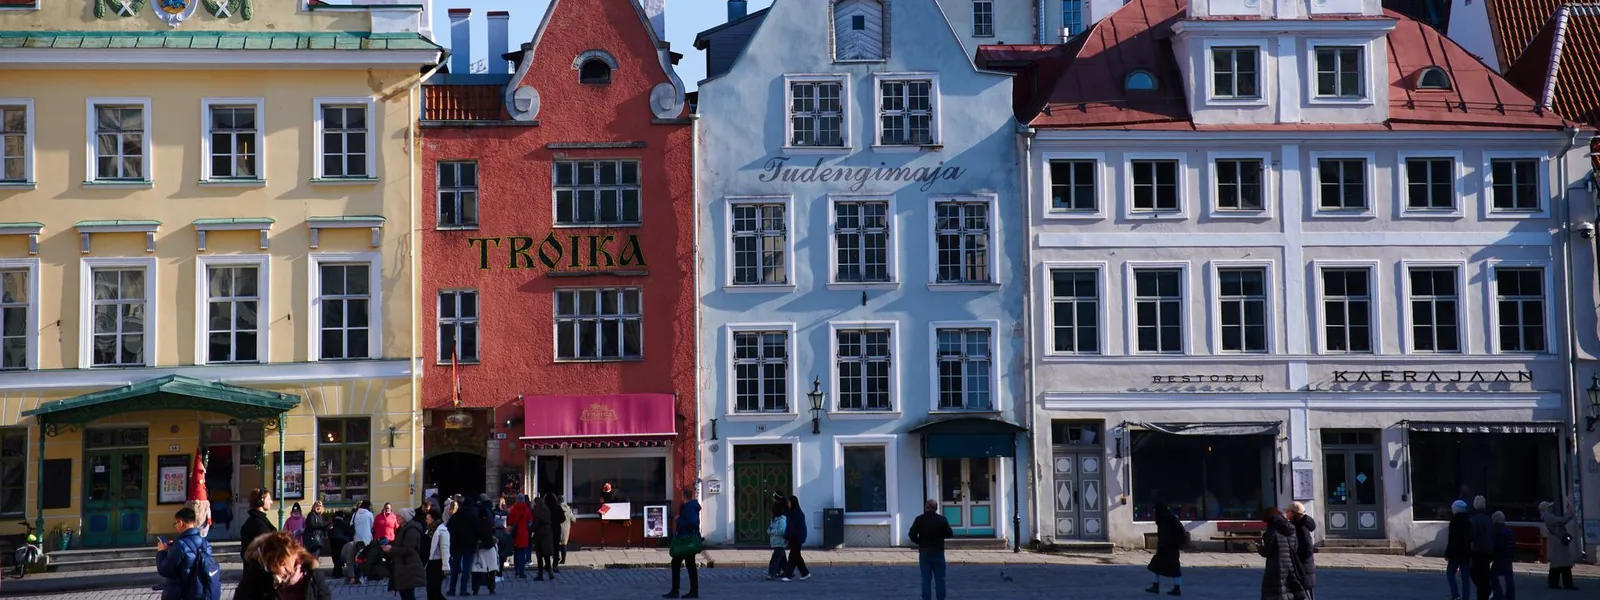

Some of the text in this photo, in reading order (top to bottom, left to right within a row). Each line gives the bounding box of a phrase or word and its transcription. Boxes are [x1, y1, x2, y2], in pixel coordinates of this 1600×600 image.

[758, 156, 967, 192] Tudengimaja
[468, 232, 647, 270] TROIKA
[1152, 370, 1533, 384] RESTORAN KAERAJAAN
